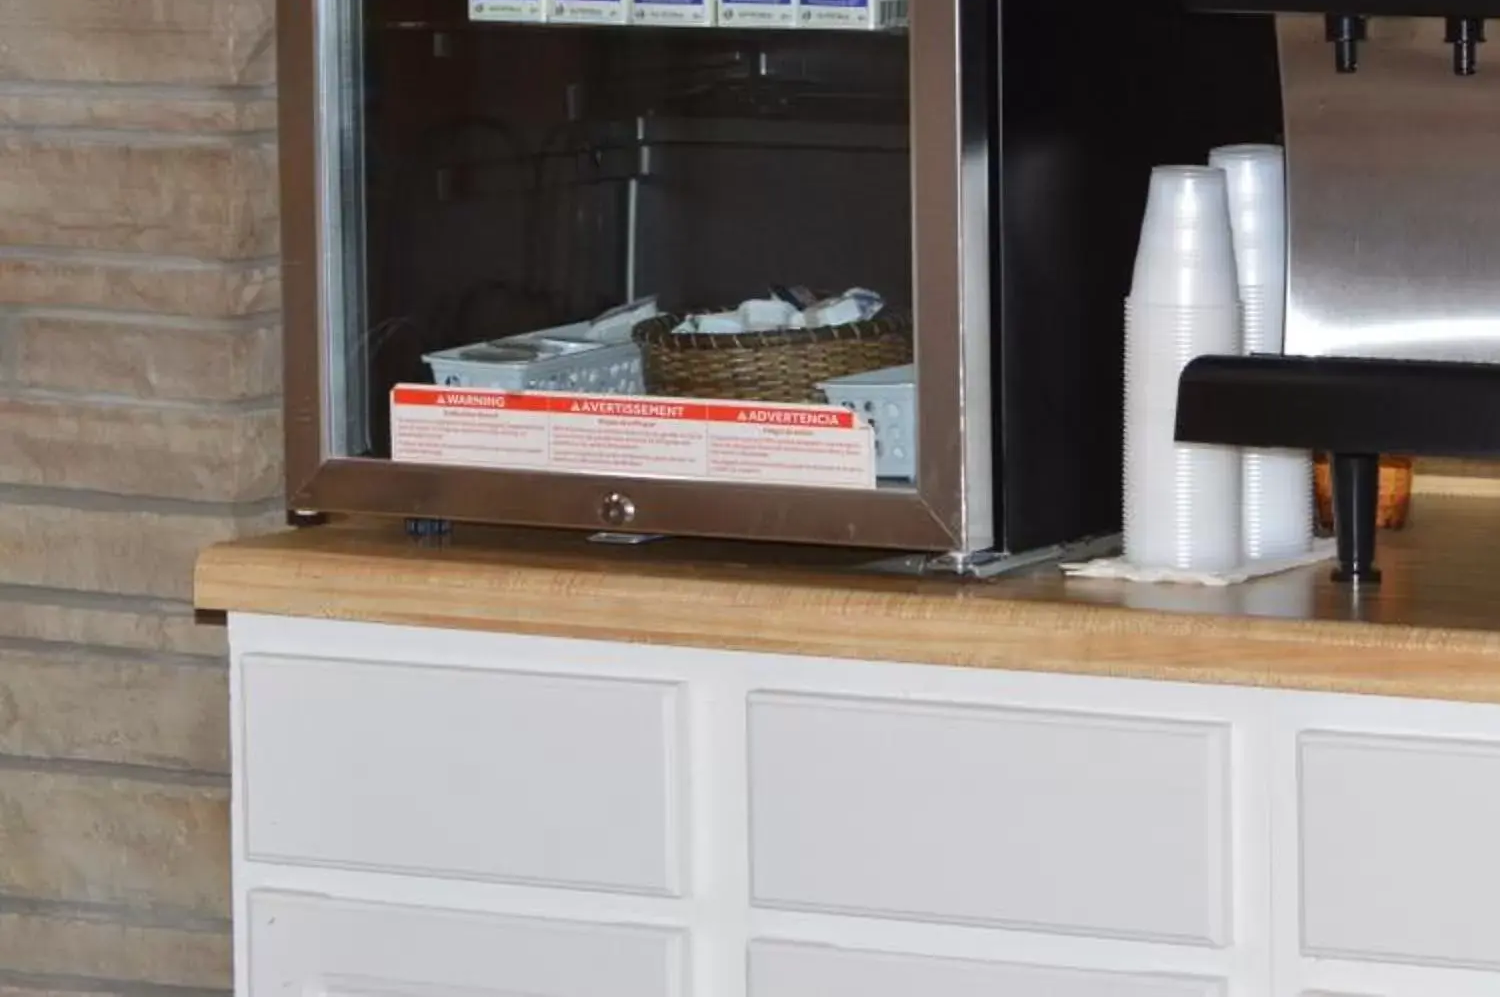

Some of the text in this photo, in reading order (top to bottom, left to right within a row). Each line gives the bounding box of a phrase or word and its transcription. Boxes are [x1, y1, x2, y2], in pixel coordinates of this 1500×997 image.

[447, 394, 505, 408] WARNING
[581, 400, 685, 418] AVERTISSEMENT
[748, 410, 839, 425] ADVERTENCIA
